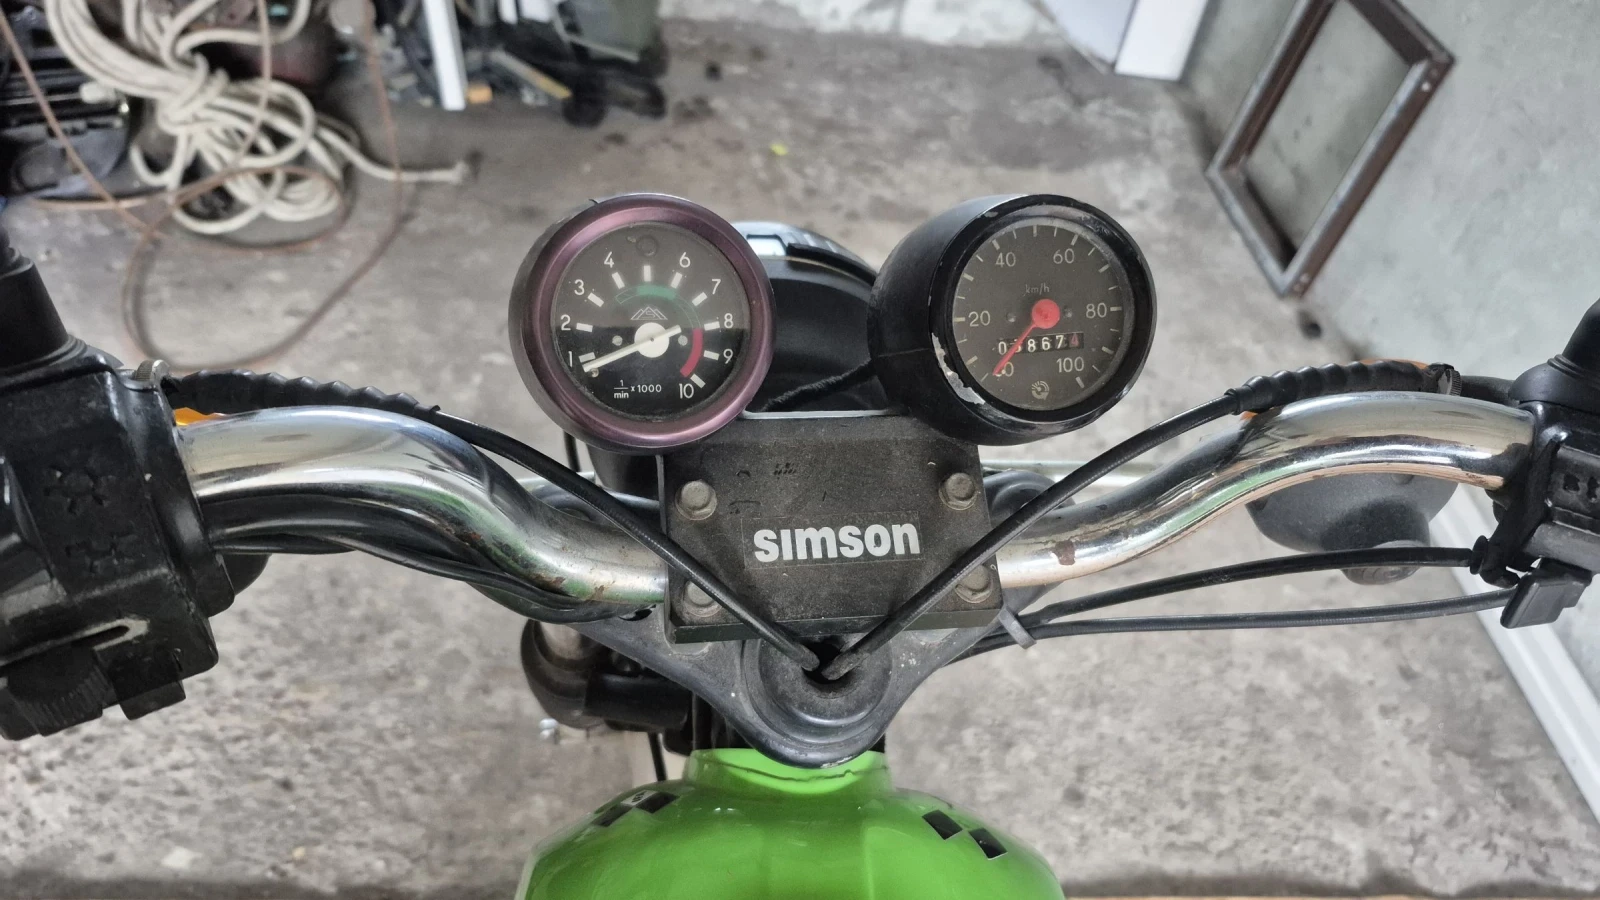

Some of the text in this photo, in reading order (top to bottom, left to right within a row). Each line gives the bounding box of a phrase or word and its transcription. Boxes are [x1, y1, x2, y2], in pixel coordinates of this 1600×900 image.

[603, 251, 615, 268] 4
[679, 251, 691, 268] 6
[995, 251, 1016, 268] 40
[1053, 248, 1075, 265] 60
[573, 279, 585, 296] 3
[711, 279, 721, 295] 7
[1025, 283, 1050, 294] km/h
[968, 310, 990, 327] 20
[1085, 302, 1106, 319] 80
[560, 314, 572, 331] 2
[724, 313, 734, 329] 8
[568, 351, 573, 367] 1
[723, 349, 734, 365] 9
[1056, 356, 1085, 373] 100
[614, 391, 630, 399] min
[637, 384, 662, 393] 1000
[679, 383, 695, 399] 10
[753, 522, 920, 563] simson
